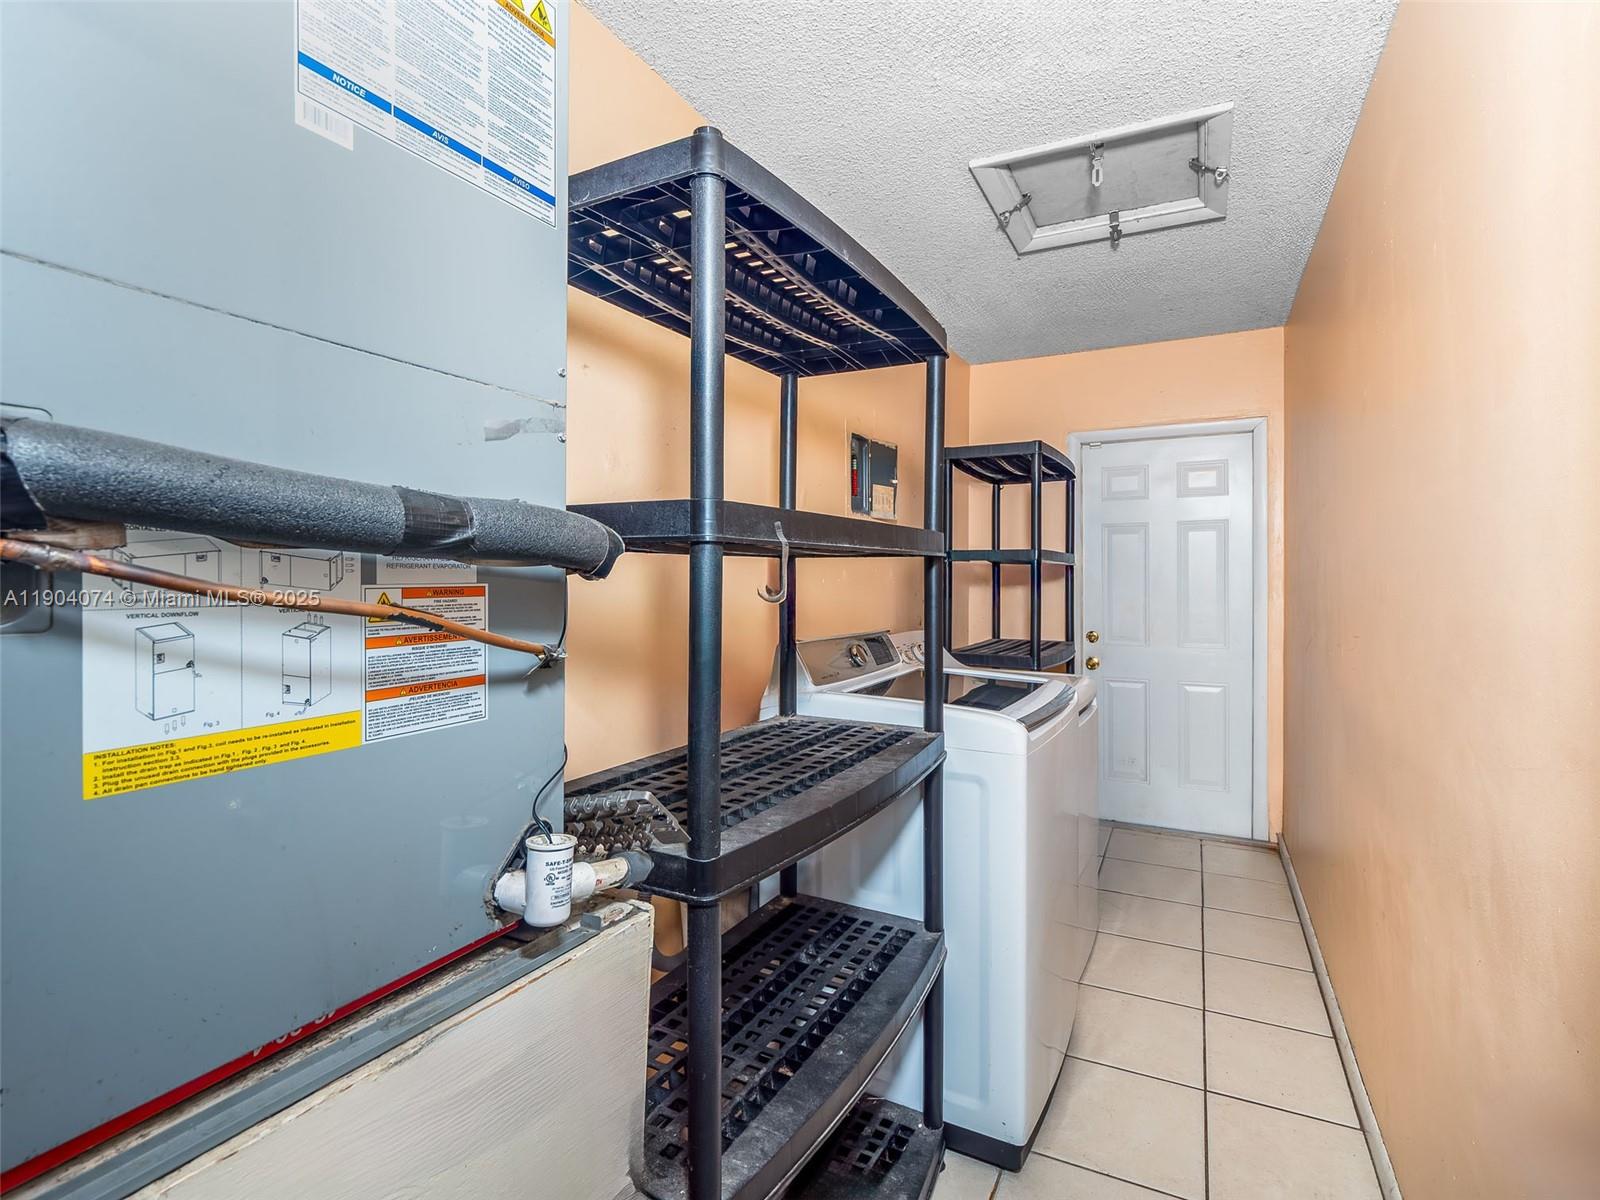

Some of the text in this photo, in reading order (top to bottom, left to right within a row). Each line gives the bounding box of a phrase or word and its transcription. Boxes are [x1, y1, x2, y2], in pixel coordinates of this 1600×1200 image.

[332, 72, 368, 98] NOTICE
[432, 130, 449, 145] AVIS
[512, 175, 531, 191] AVISO
[386, 562, 431, 570] REFRIGERANT
[432, 588, 465, 597] WARNING
[408, 680, 458, 693] ADVERTENCIA
[93, 747, 148, 759] INSTALLATION
[116, 753, 155, 762] installation
[183, 756, 212, 764] indicated
[102, 762, 141, 772] instruction
[180, 762, 215, 771] connection
